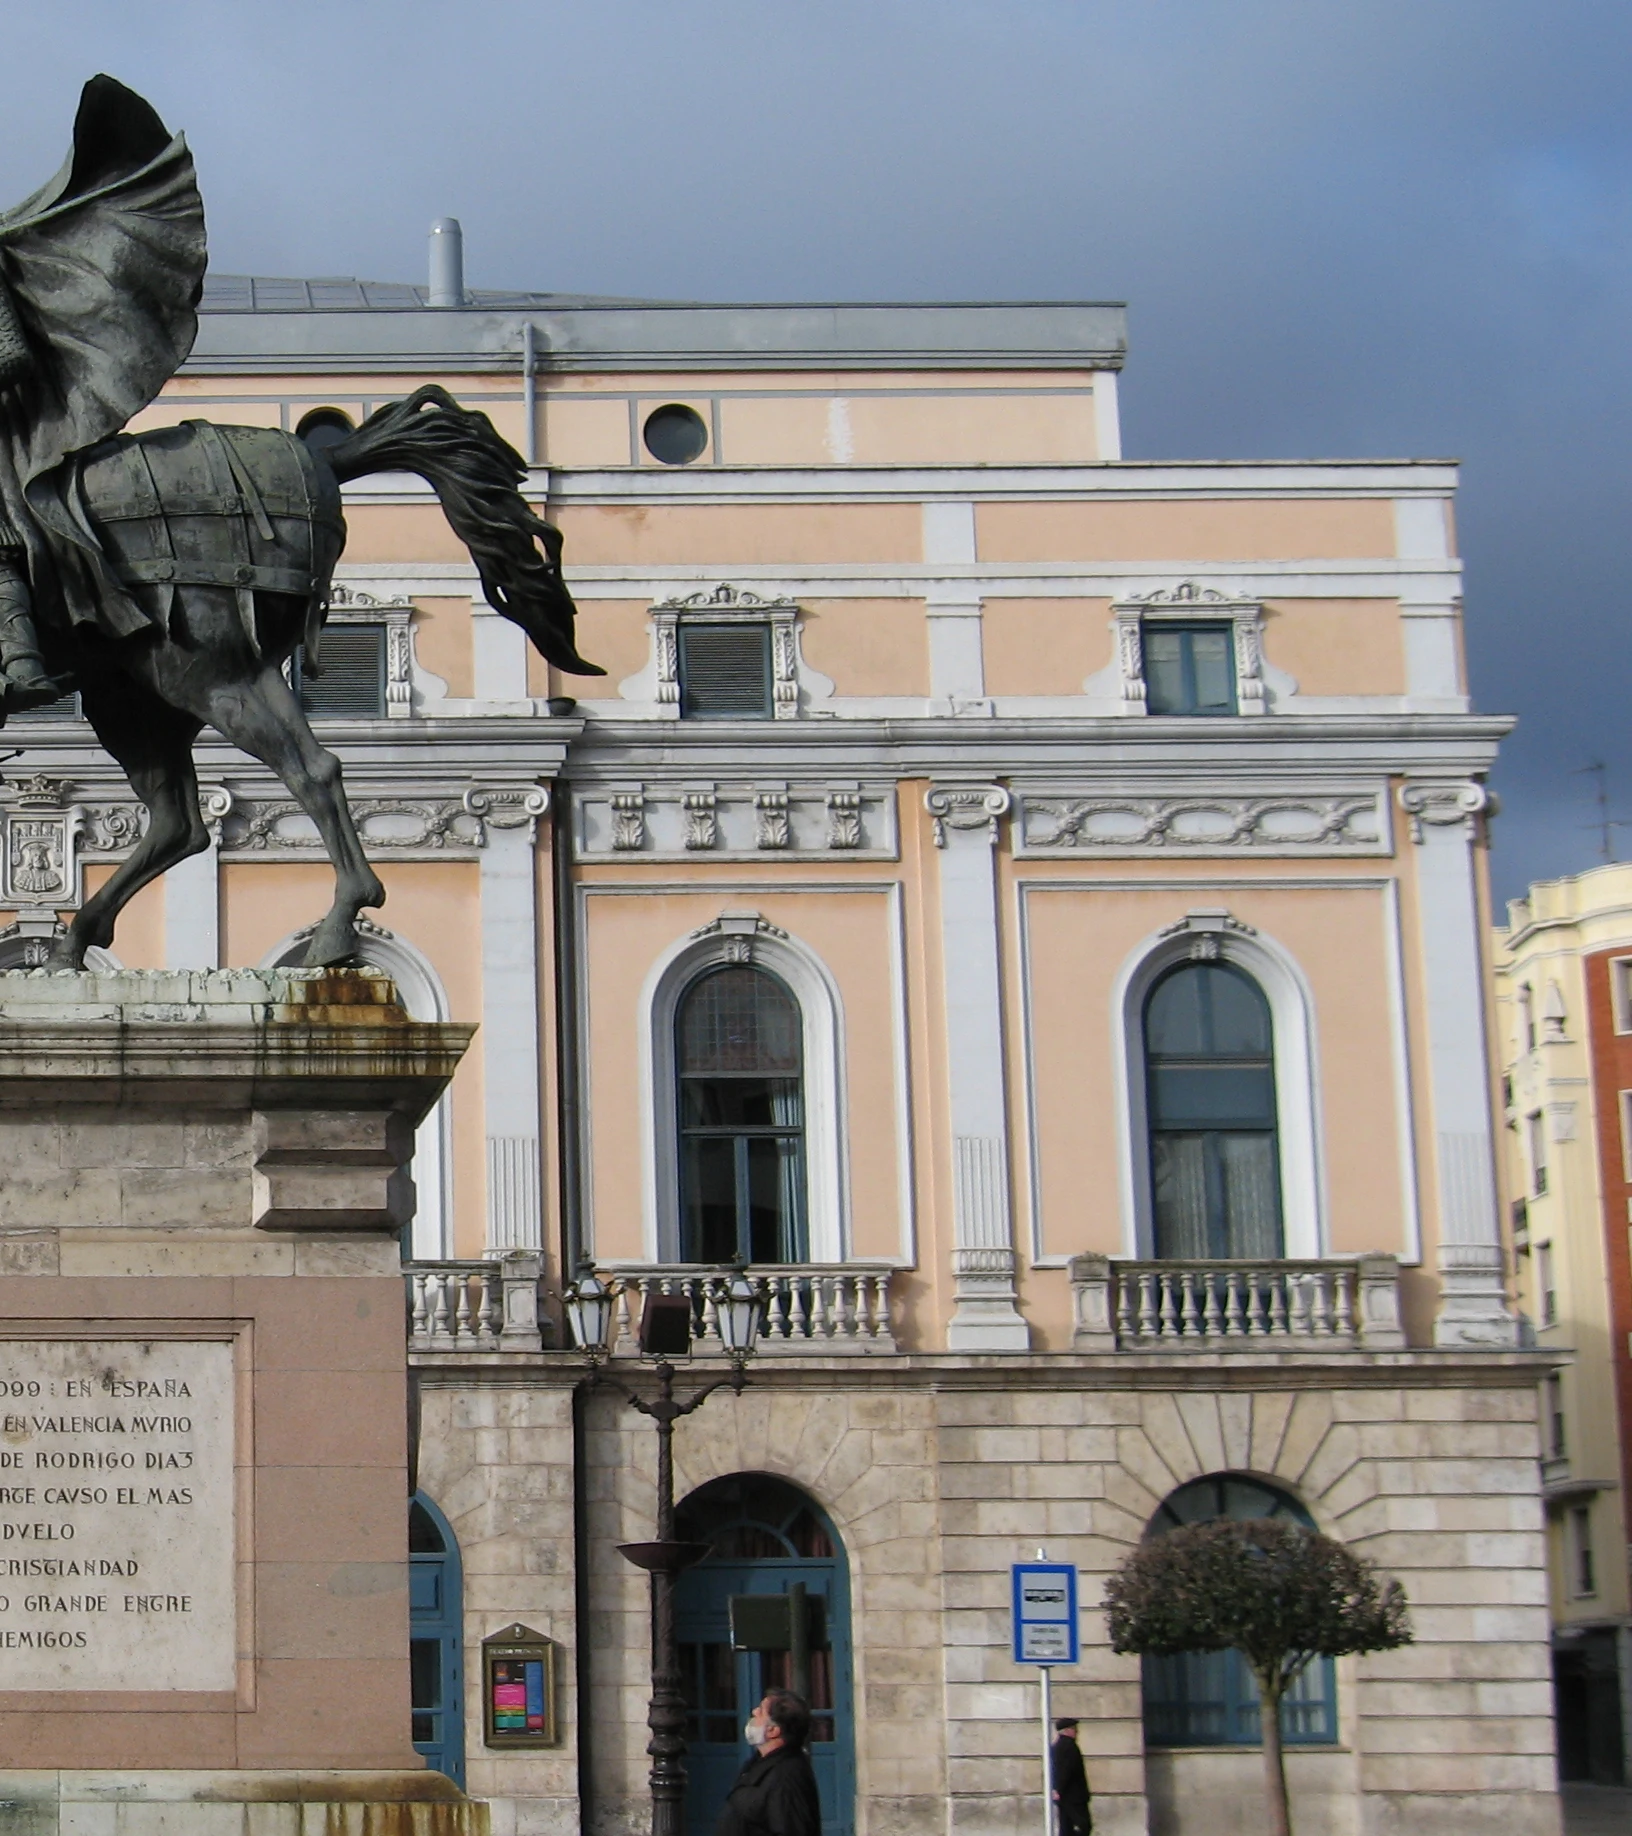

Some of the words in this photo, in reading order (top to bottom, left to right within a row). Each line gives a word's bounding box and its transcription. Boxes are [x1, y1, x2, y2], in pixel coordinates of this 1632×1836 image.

[66, 1379, 92, 1398] EN
[110, 1379, 192, 1398] ESPAÑA
[4, 1416, 26, 1433] EN
[32, 1416, 126, 1433] VALENCIA
[35, 1451, 136, 1469] RODRIGO
[116, 1487, 139, 1506] EL
[147, 1487, 193, 1506] MAS
[23, 1594, 108, 1613] GRANDE
[123, 1594, 192, 1613] ENTRE
